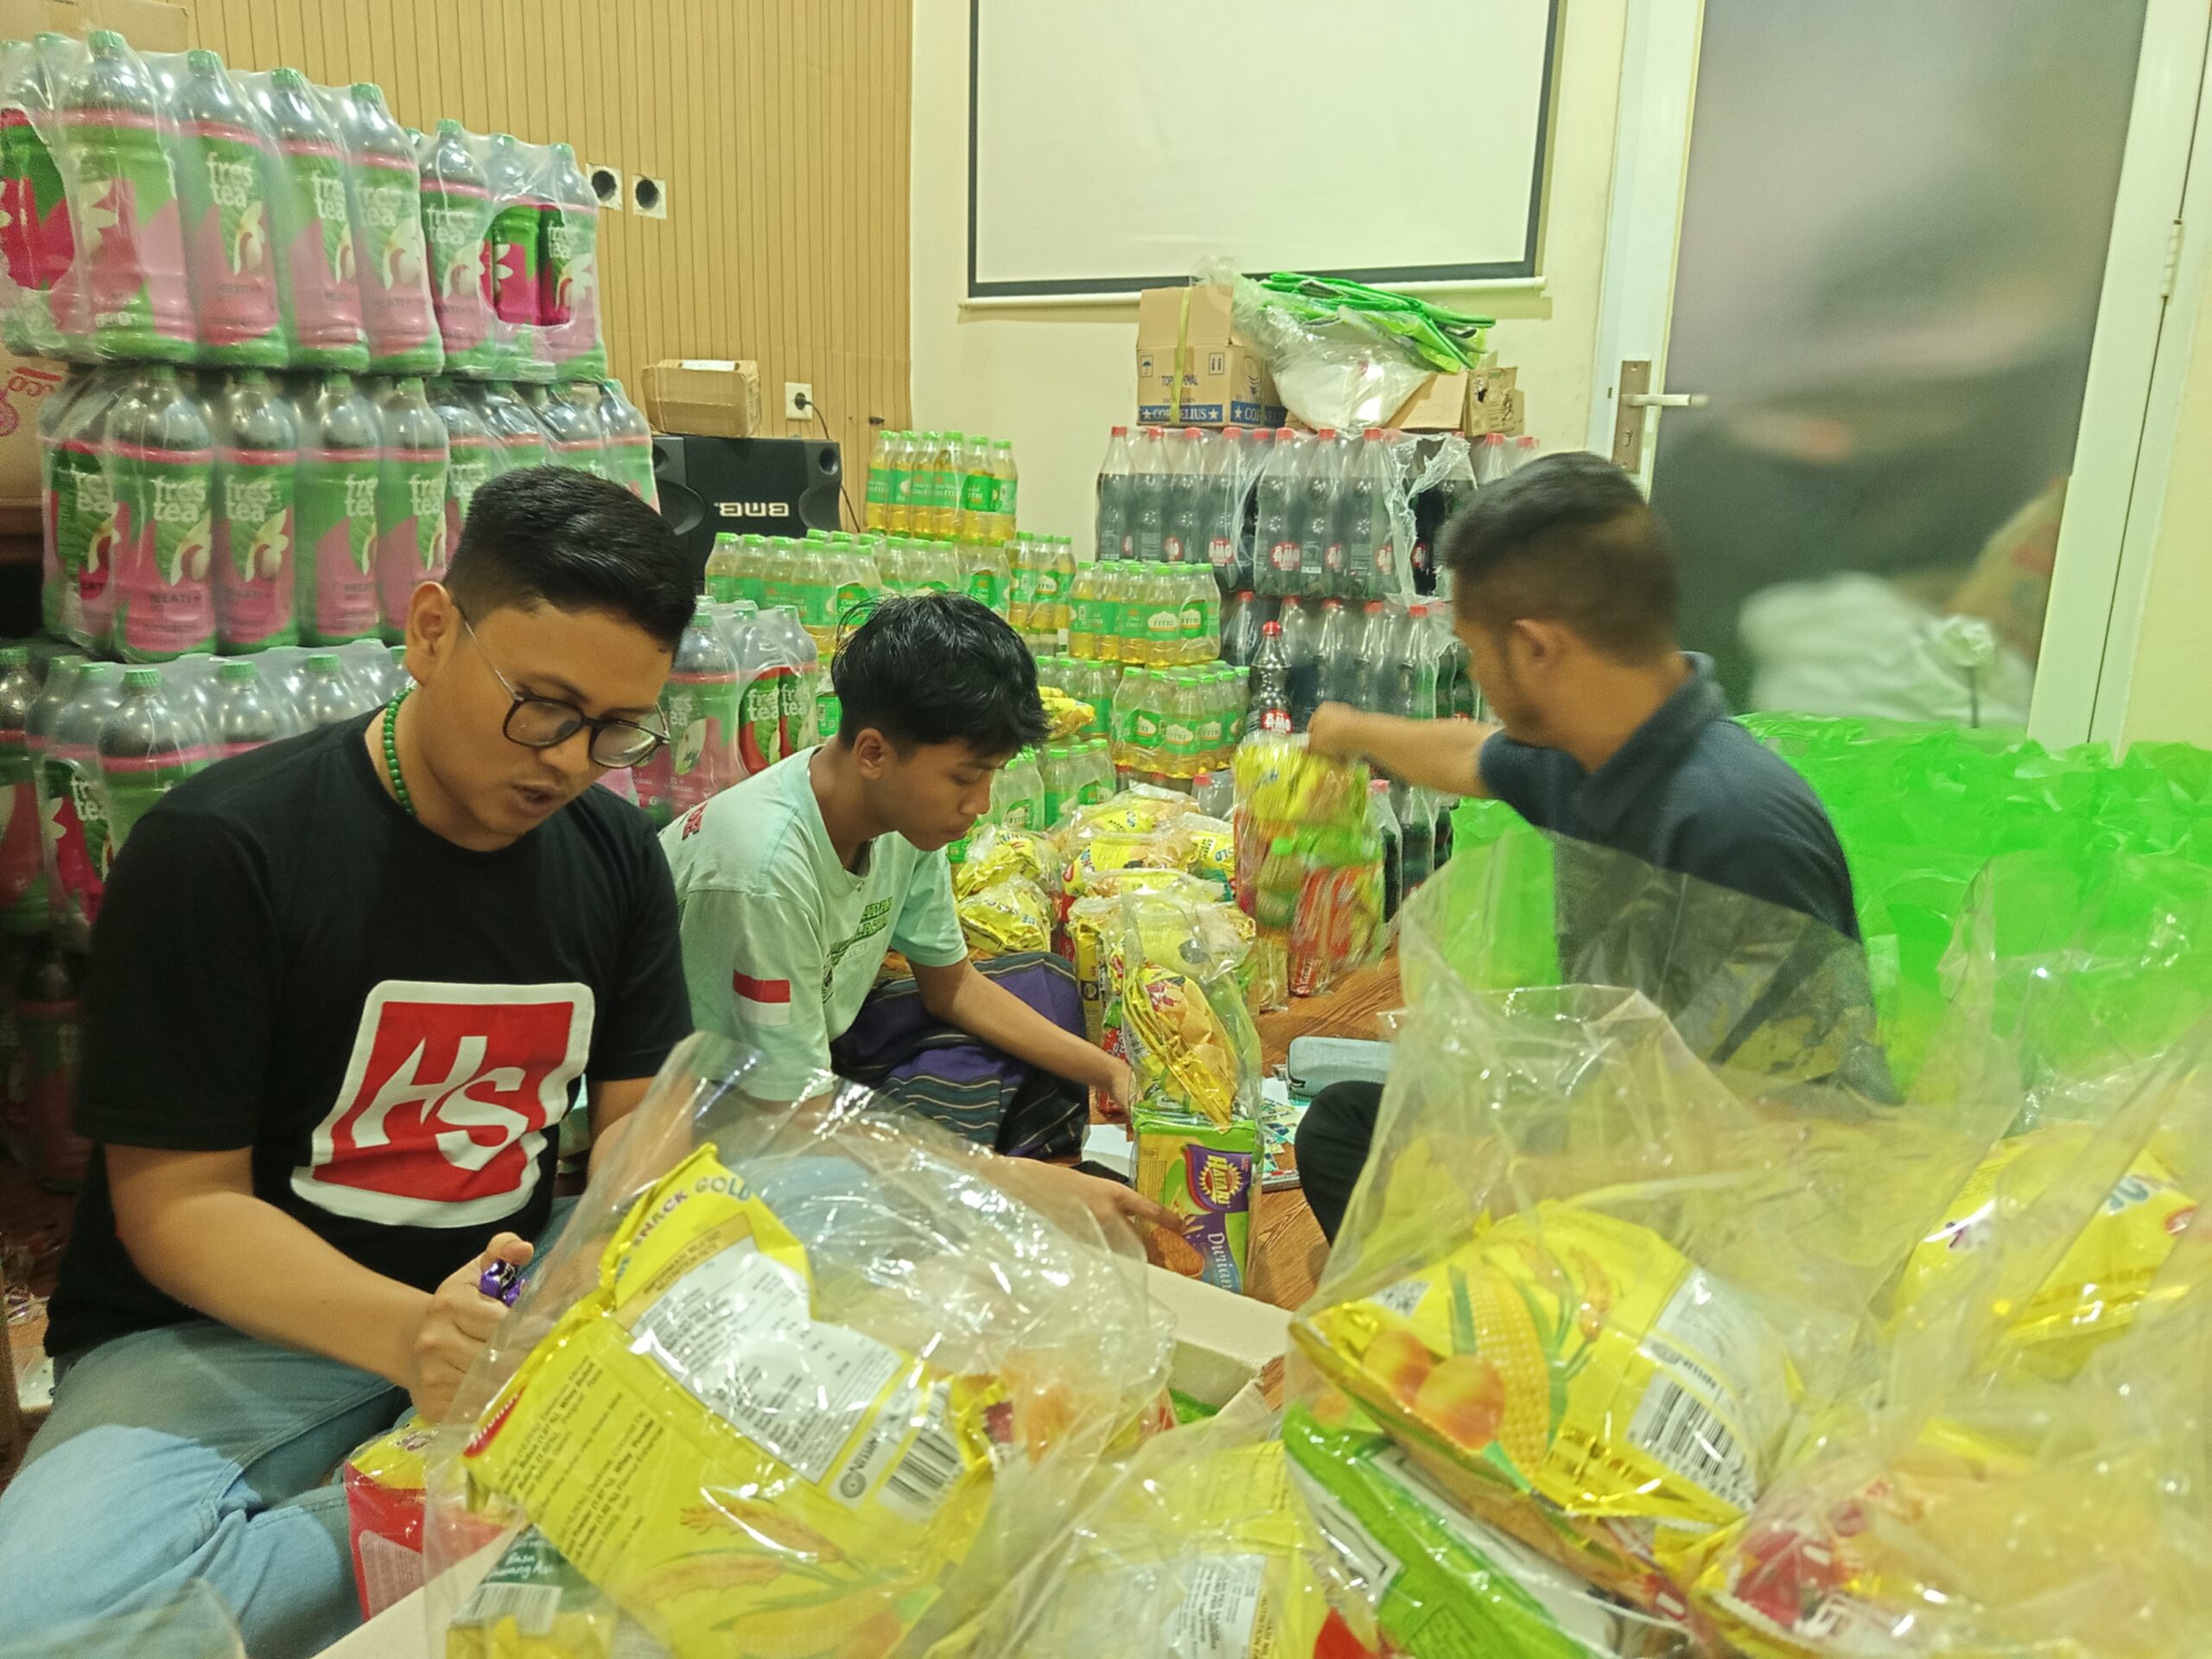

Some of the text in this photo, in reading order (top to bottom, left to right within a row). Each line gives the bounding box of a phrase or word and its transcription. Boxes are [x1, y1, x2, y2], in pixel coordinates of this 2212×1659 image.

[209, 183, 247, 208] tea
[150, 474, 207, 505] fres
[224, 474, 273, 501] fres
[153, 499, 200, 523] tea
[225, 496, 266, 522] tea
[670, 711, 688, 727] ea
[748, 701, 779, 721] tea
[783, 699, 808, 716] tea
[1207, 1154, 1231, 1205] HATARI
[632, 1177, 752, 1248] SNACK GOLD
[1207, 1232, 1234, 1289] Durian
